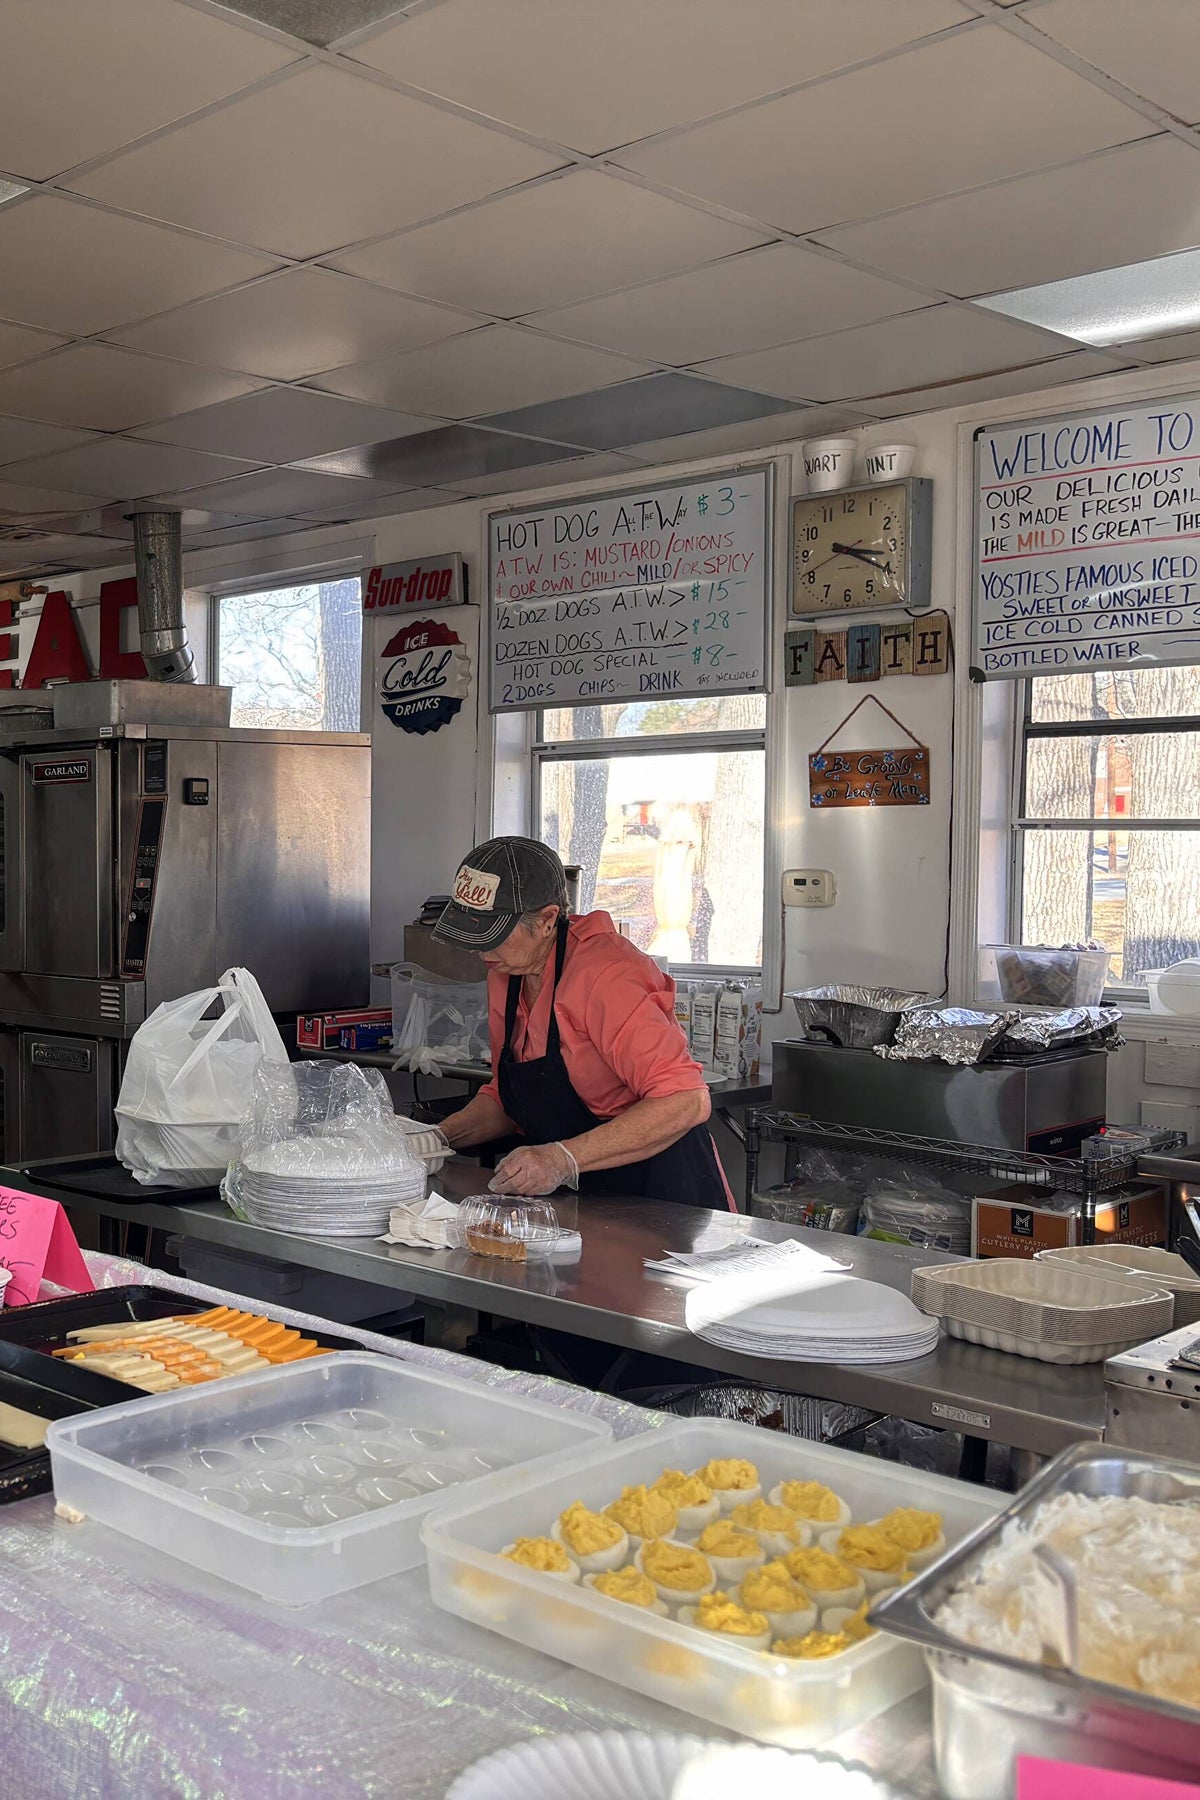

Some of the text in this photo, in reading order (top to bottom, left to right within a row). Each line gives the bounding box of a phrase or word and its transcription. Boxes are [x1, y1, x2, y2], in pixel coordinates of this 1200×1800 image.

[990, 412, 1193, 480] WELCOME TO
[804, 454, 841, 476] QUART
[866, 453, 897, 476] PINT
[986, 485, 1035, 510] OUR
[1056, 467, 1184, 501] DELICIOUS
[823, 508, 833, 523] 11
[843, 500, 855, 514] 12
[868, 502, 873, 517] 1
[991, 512, 1011, 531] IS
[1019, 504, 1072, 527] MADE
[1082, 495, 1141, 519] FRESH
[497, 519, 544, 552] HOT
[554, 510, 600, 543] DOG
[806, 526, 818, 541] 10
[883, 516, 891, 531] 2
[889, 538, 897, 552] 3
[982, 536, 1012, 556] THE
[1017, 528, 1065, 552] MILD
[1072, 524, 1088, 544] IS
[802, 550, 810, 563] 9
[510, 580, 537, 599] OUR
[542, 576, 573, 592] OWN
[704, 553, 754, 574] SPICY
[808, 570, 816, 584] 8
[865, 580, 874, 594] 5
[981, 556, 1197, 600] YOSTIES FAMOUS ICED
[364, 567, 453, 609] Sun-drop
[823, 584, 831, 598] 7
[843, 589, 851, 603] 6
[1002, 595, 1069, 618] SWEET
[1099, 583, 1197, 609] UNSWEET
[519, 609, 550, 626] DOZ.
[555, 598, 600, 621] DOGS
[986, 623, 1016, 644] ICE
[1024, 618, 1082, 637] COLD
[1094, 610, 1183, 630] CANNED
[404, 632, 429, 651] ICE
[496, 639, 549, 662] DOZEN
[556, 631, 603, 654] DOGS
[789, 631, 942, 675] FAITH
[985, 641, 1142, 671] BOTTLED WATER
[382, 650, 453, 692] Cold
[513, 662, 545, 681] HOT
[551, 660, 584, 676] DOG
[594, 652, 658, 672] SPECIAL
[640, 670, 683, 692] DRINK
[395, 697, 441, 717] DRINKS
[44, 765, 87, 776] GARLAND
[981, 1237, 1021, 1251] CUTLERY
[996, 1234, 1049, 1248] WHITE PLASTIC
